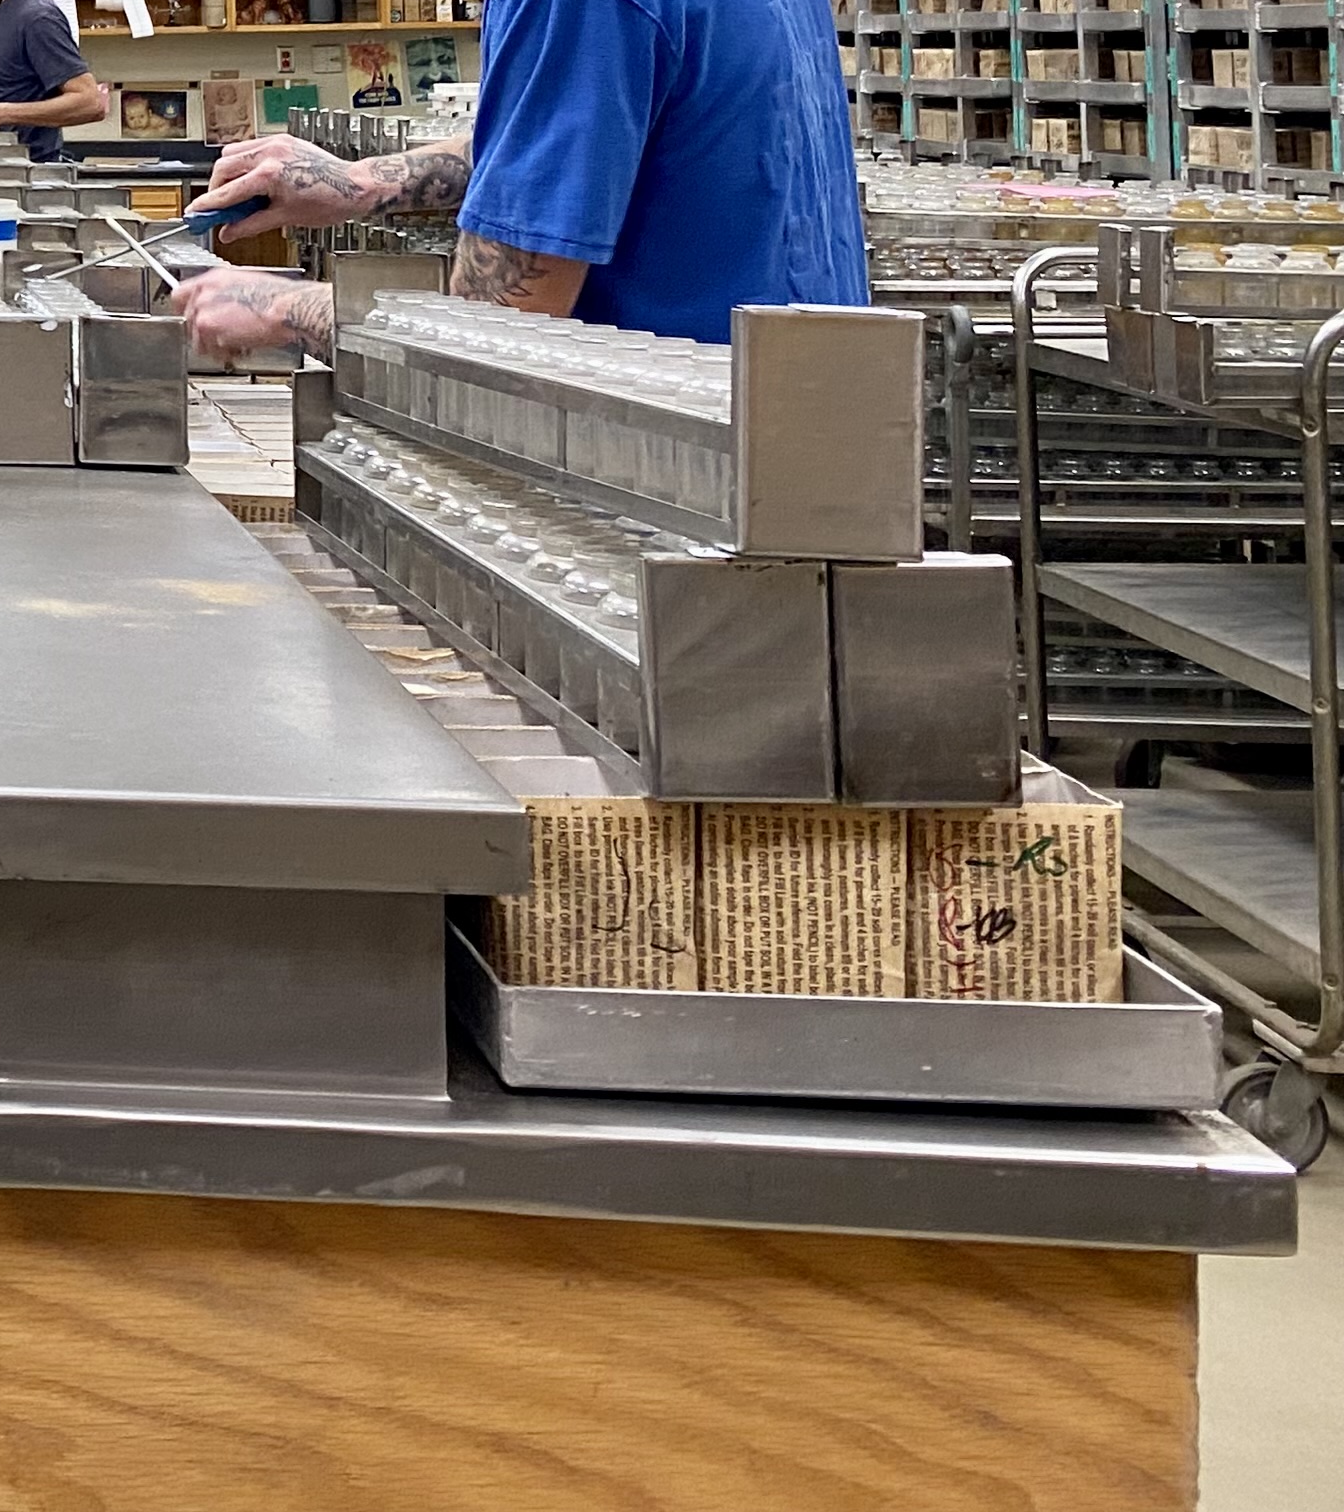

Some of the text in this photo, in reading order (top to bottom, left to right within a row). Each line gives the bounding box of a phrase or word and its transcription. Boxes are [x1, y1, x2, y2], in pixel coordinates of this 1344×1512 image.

[758, 851, 769, 893] OVERFILL
[759, 896, 770, 913] BOX
[891, 887, 900, 919] PLEASE
[759, 916, 770, 928] OR
[760, 931, 771, 947] PUT
[892, 922, 901, 946] READ
[761, 950, 772, 968] SOIL
